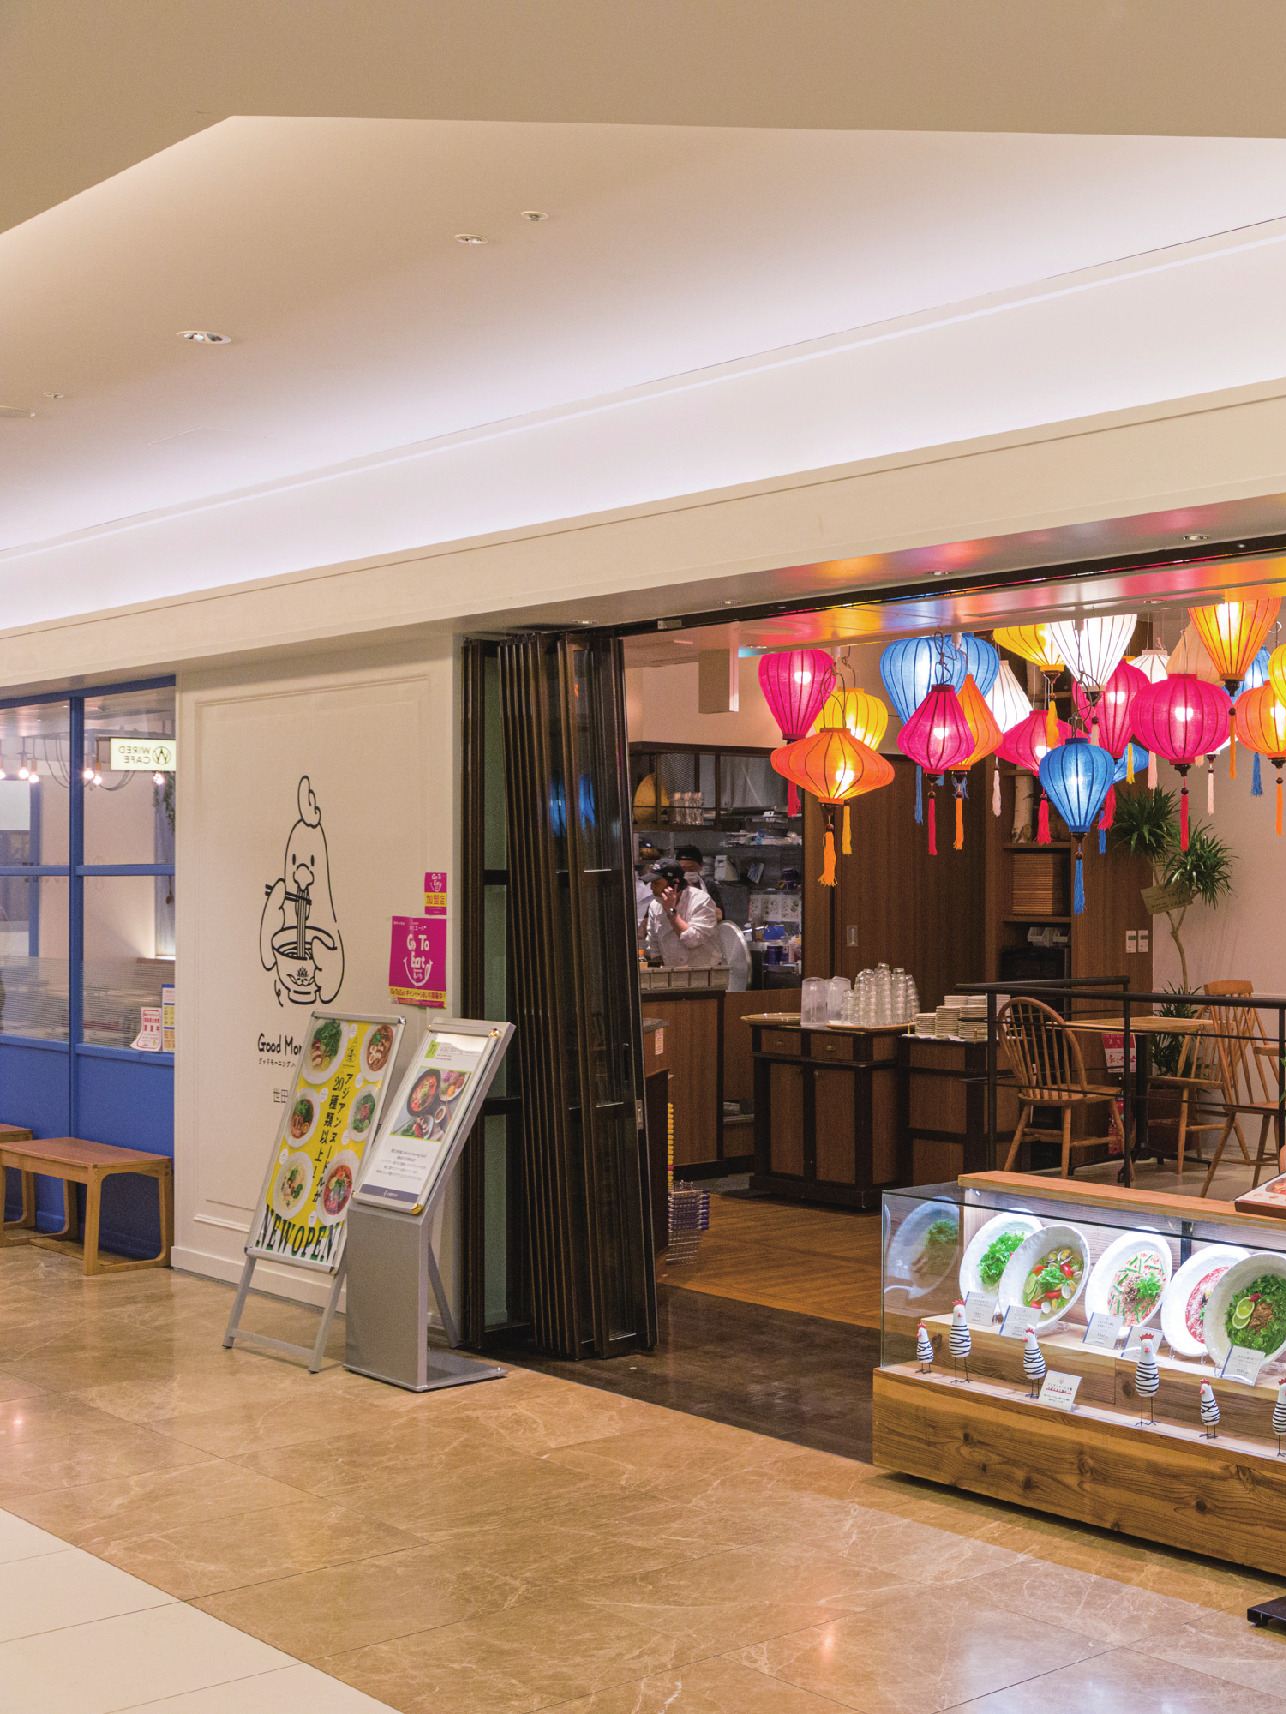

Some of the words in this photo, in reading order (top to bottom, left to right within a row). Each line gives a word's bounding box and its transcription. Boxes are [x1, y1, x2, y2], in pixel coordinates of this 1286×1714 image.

[406, 934, 416, 950] Go
[418, 934, 429, 950] To
[410, 952, 425, 968] Eat
[258, 1033, 281, 1054] Good
